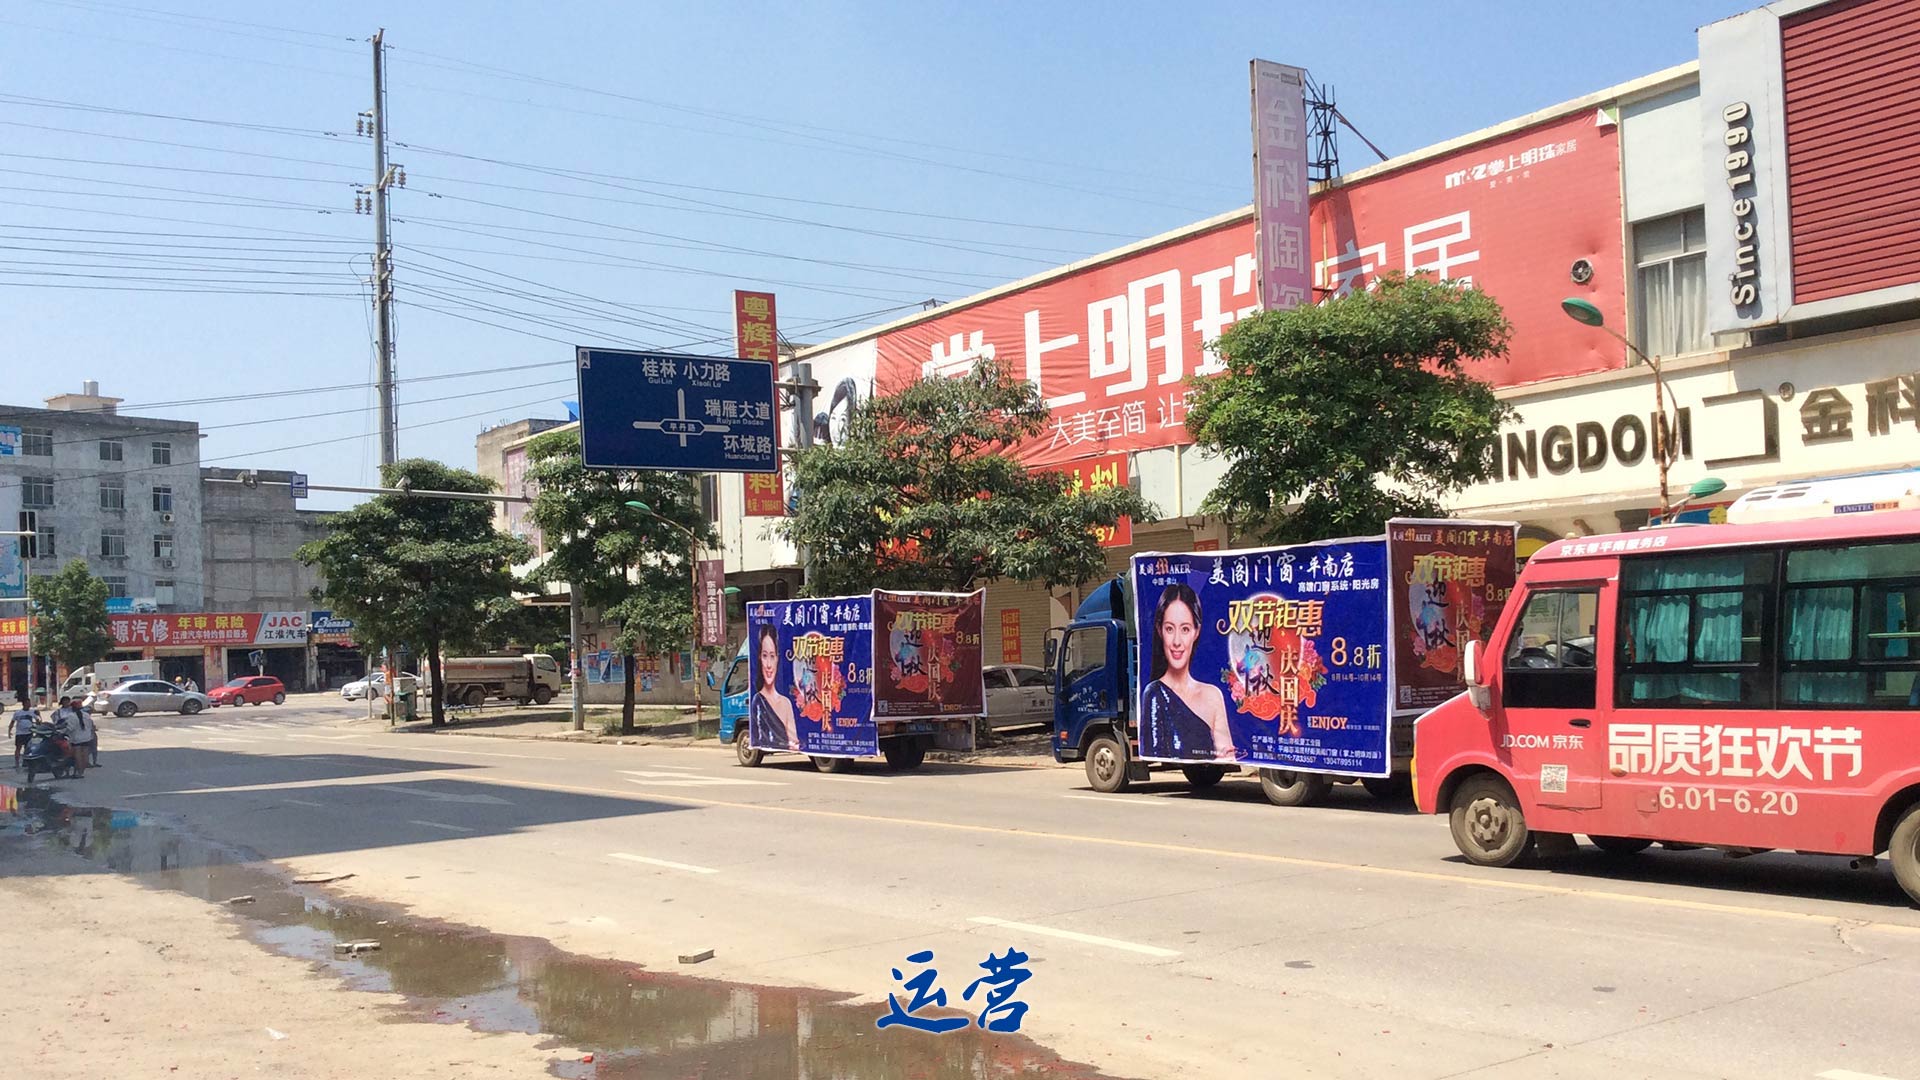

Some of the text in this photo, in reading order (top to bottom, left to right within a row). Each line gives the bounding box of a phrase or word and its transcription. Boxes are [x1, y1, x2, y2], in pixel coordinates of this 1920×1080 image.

[641, 358, 731, 382] 桂林 小力路
[704, 399, 770, 420] 瑞雁大道
[1049, 401, 1147, 449] 大美至简
[1472, 374, 1920, 486] INGDOM 金科
[723, 435, 772, 454] 环城路
[761, 453, 771, 461] Lu
[1405, 555, 1487, 587] 双节钜惠
[111, 618, 169, 644] 源汽修
[177, 615, 246, 630] 年审 保险
[268, 616, 302, 628] JAC
[888, 611, 959, 635] 双节钜惠
[1216, 600, 1325, 637] 双节钜惠
[264, 629, 307, 640] 江淮汽车
[786, 636, 844, 662] 双节钜惠
[927, 646, 941, 701] 庆国庆
[820, 666, 833, 731] 庆国庆
[1279, 645, 1300, 735] 庆国庆
[1312, 716, 1348, 730] ENJOY
[1500, 734, 1584, 751] JD.COM 京东
[1608, 724, 1862, 780] 品质狂欢节
[1659, 786, 1798, 816] 6.01-6.20
